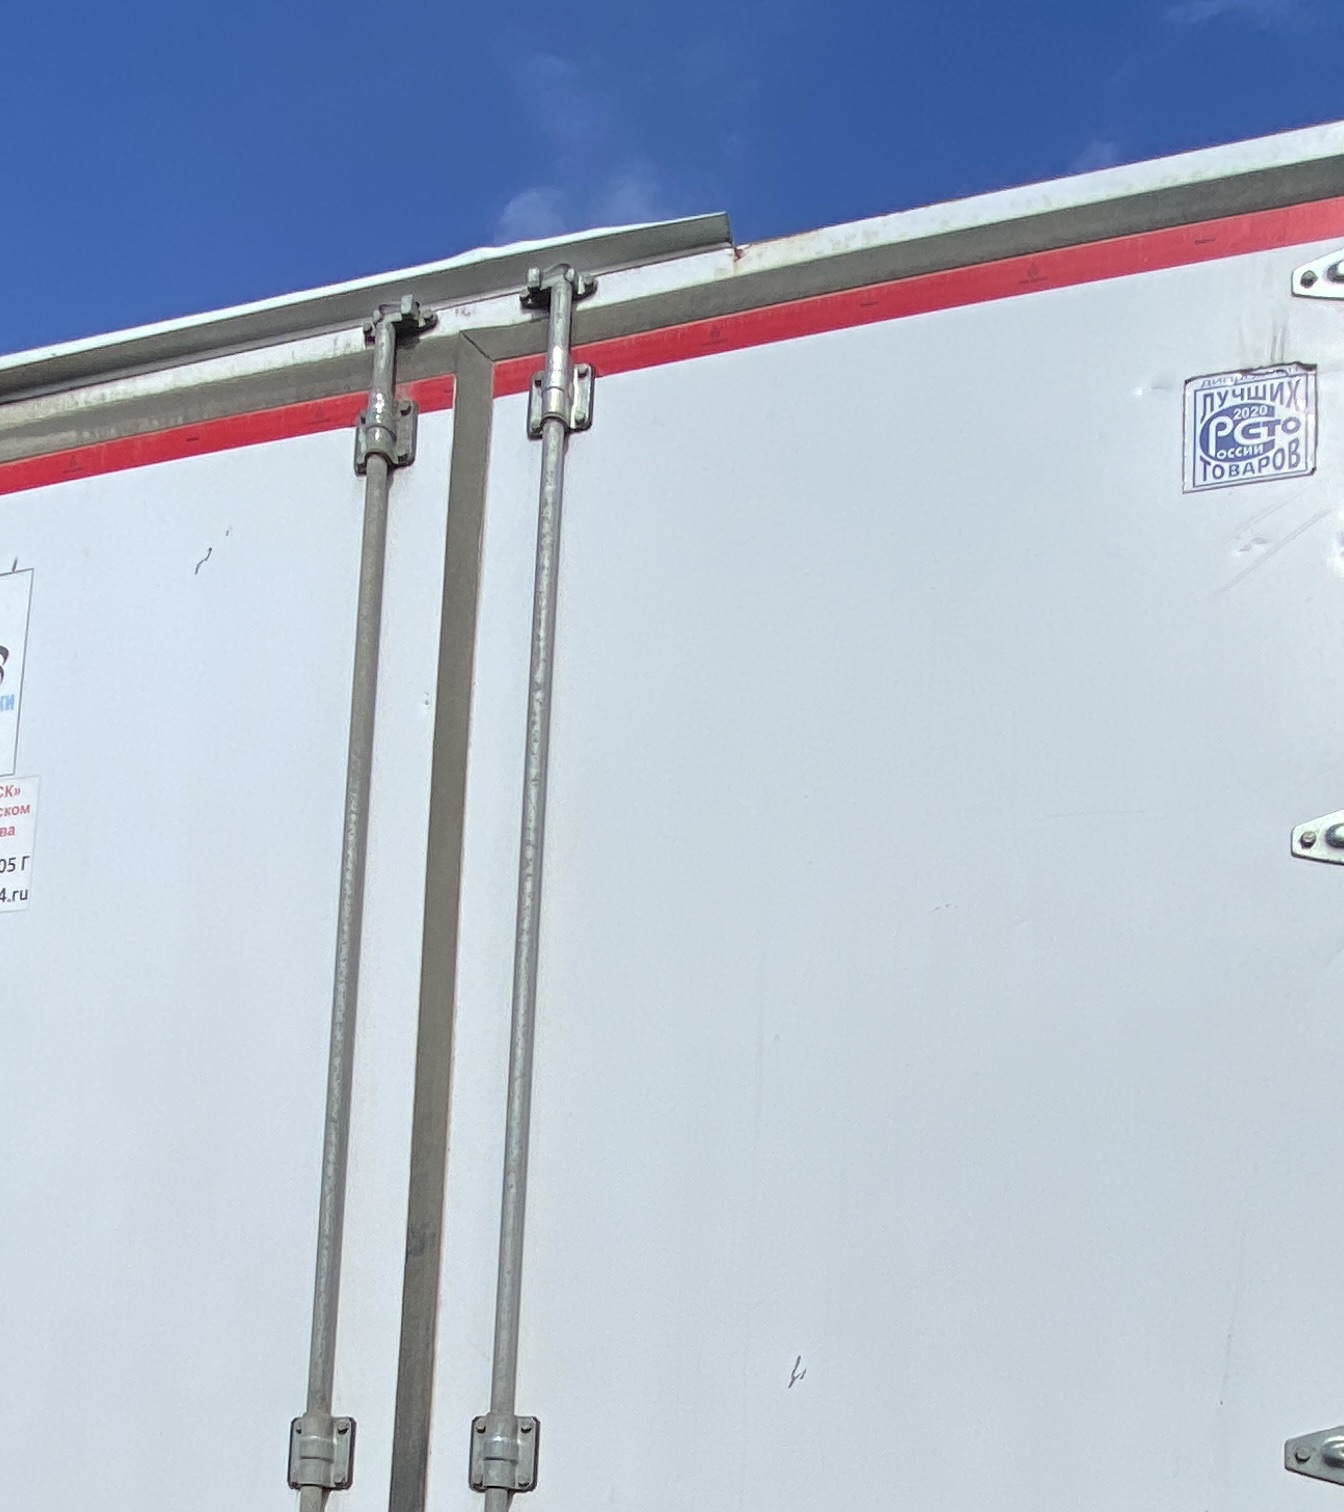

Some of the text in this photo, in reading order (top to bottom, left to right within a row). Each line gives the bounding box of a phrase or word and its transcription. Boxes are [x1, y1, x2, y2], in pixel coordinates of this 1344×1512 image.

[1200, 379, 1300, 423] ЛУЧШИХ
[1233, 405, 1269, 420] 2020
[1199, 437, 1301, 482] ТОВАРОВ
[20, 855, 31, 871] Г
